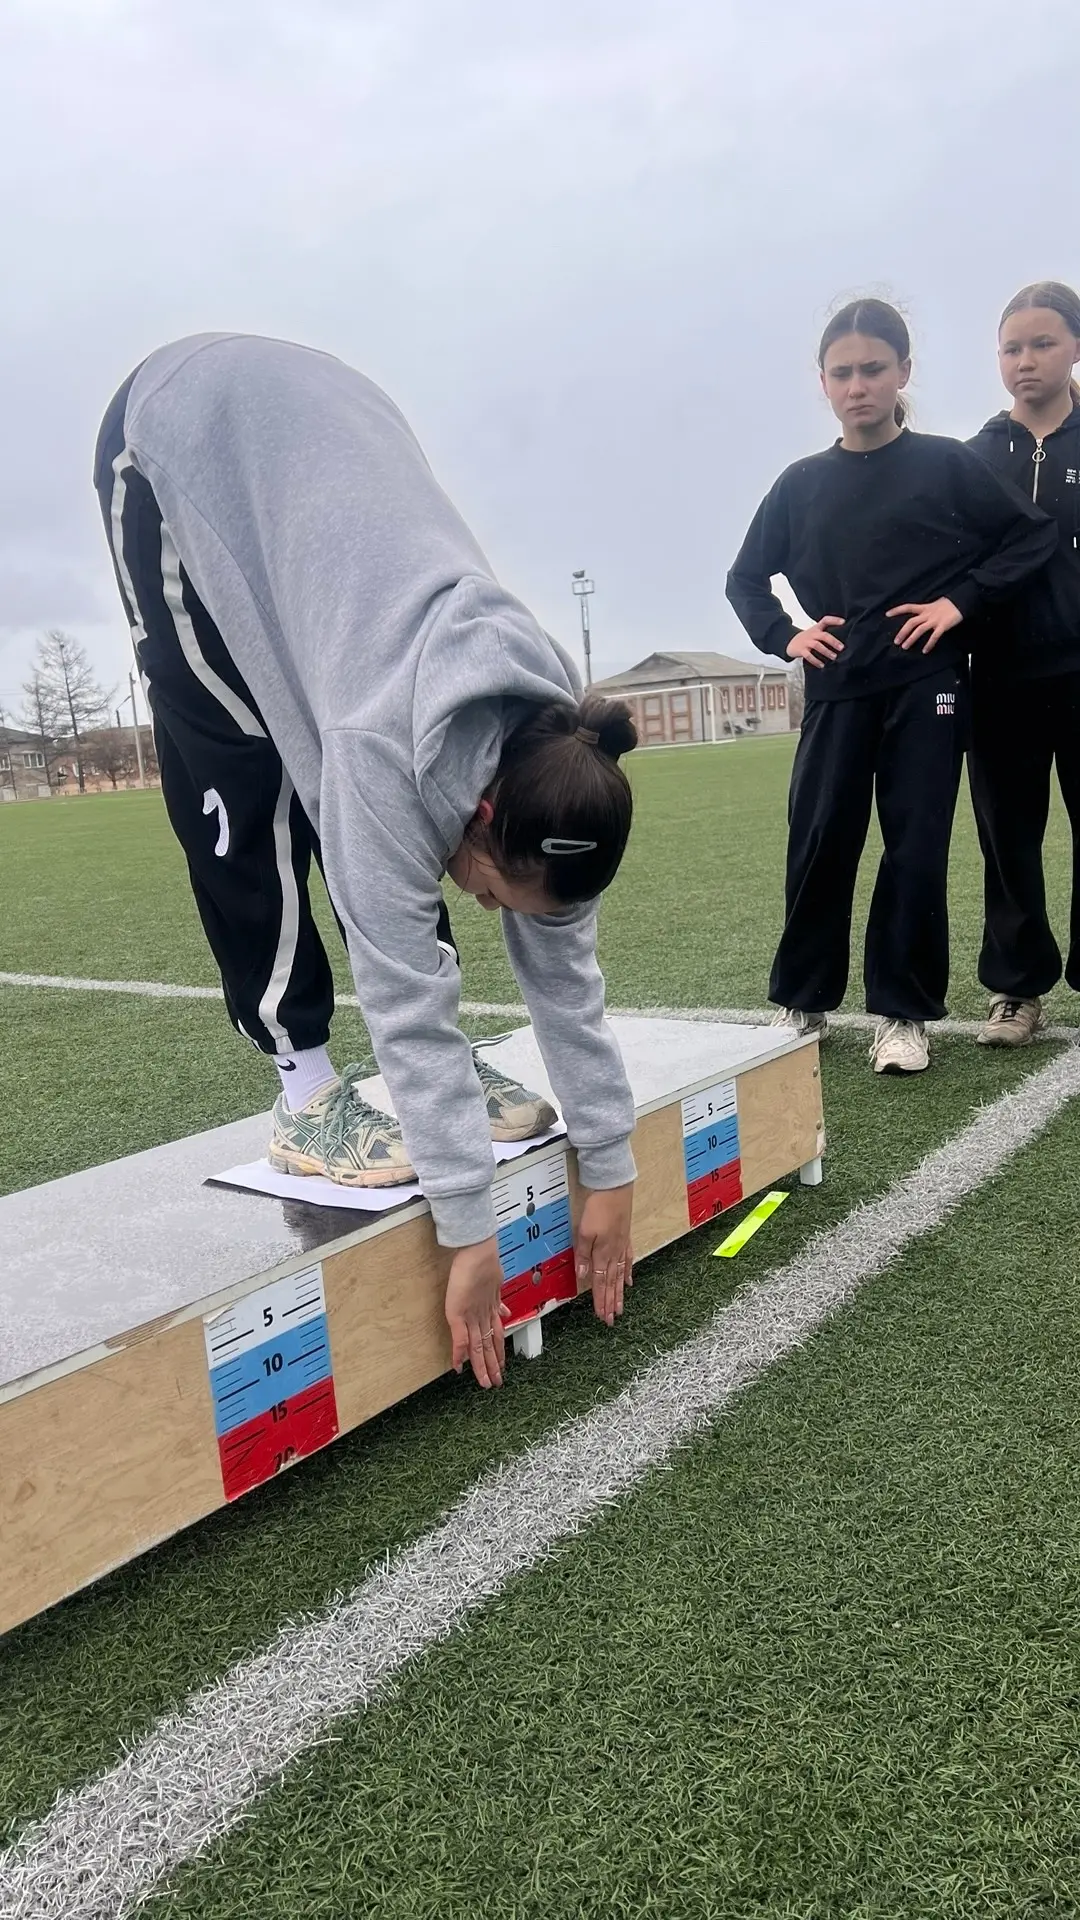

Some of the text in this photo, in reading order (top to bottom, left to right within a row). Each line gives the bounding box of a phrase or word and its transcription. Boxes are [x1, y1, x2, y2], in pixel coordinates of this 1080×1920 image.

[707, 1102, 713, 1116] 5
[707, 1134, 718, 1150] 10
[710, 1167, 720, 1183] 15
[526, 1185, 535, 1202] 5
[526, 1223, 540, 1243] 10
[263, 1306, 274, 1328] 5
[262, 1352, 284, 1377] 10
[269, 1399, 288, 1424] 15
